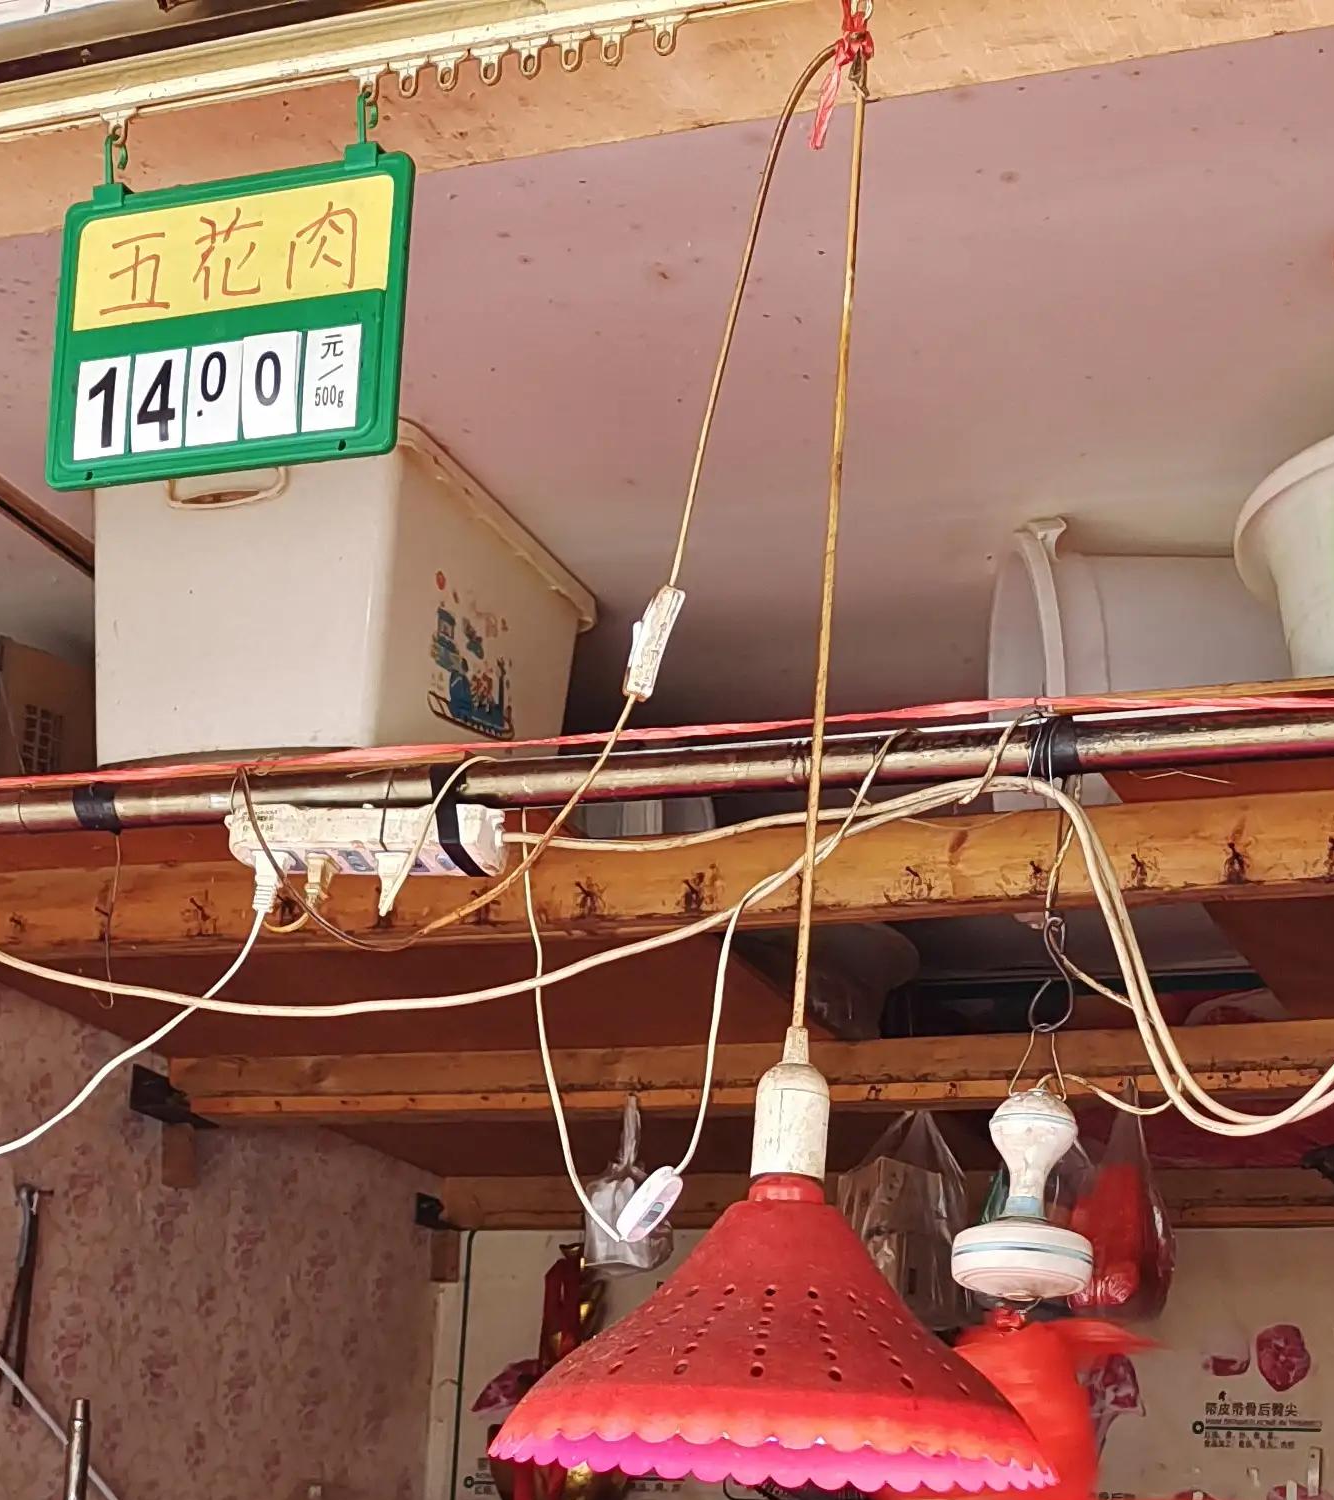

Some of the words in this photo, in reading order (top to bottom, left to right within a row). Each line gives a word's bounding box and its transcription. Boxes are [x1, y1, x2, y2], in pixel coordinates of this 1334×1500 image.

[99, 200, 358, 316] 五花肉
[87, 350, 283, 449] 14.00
